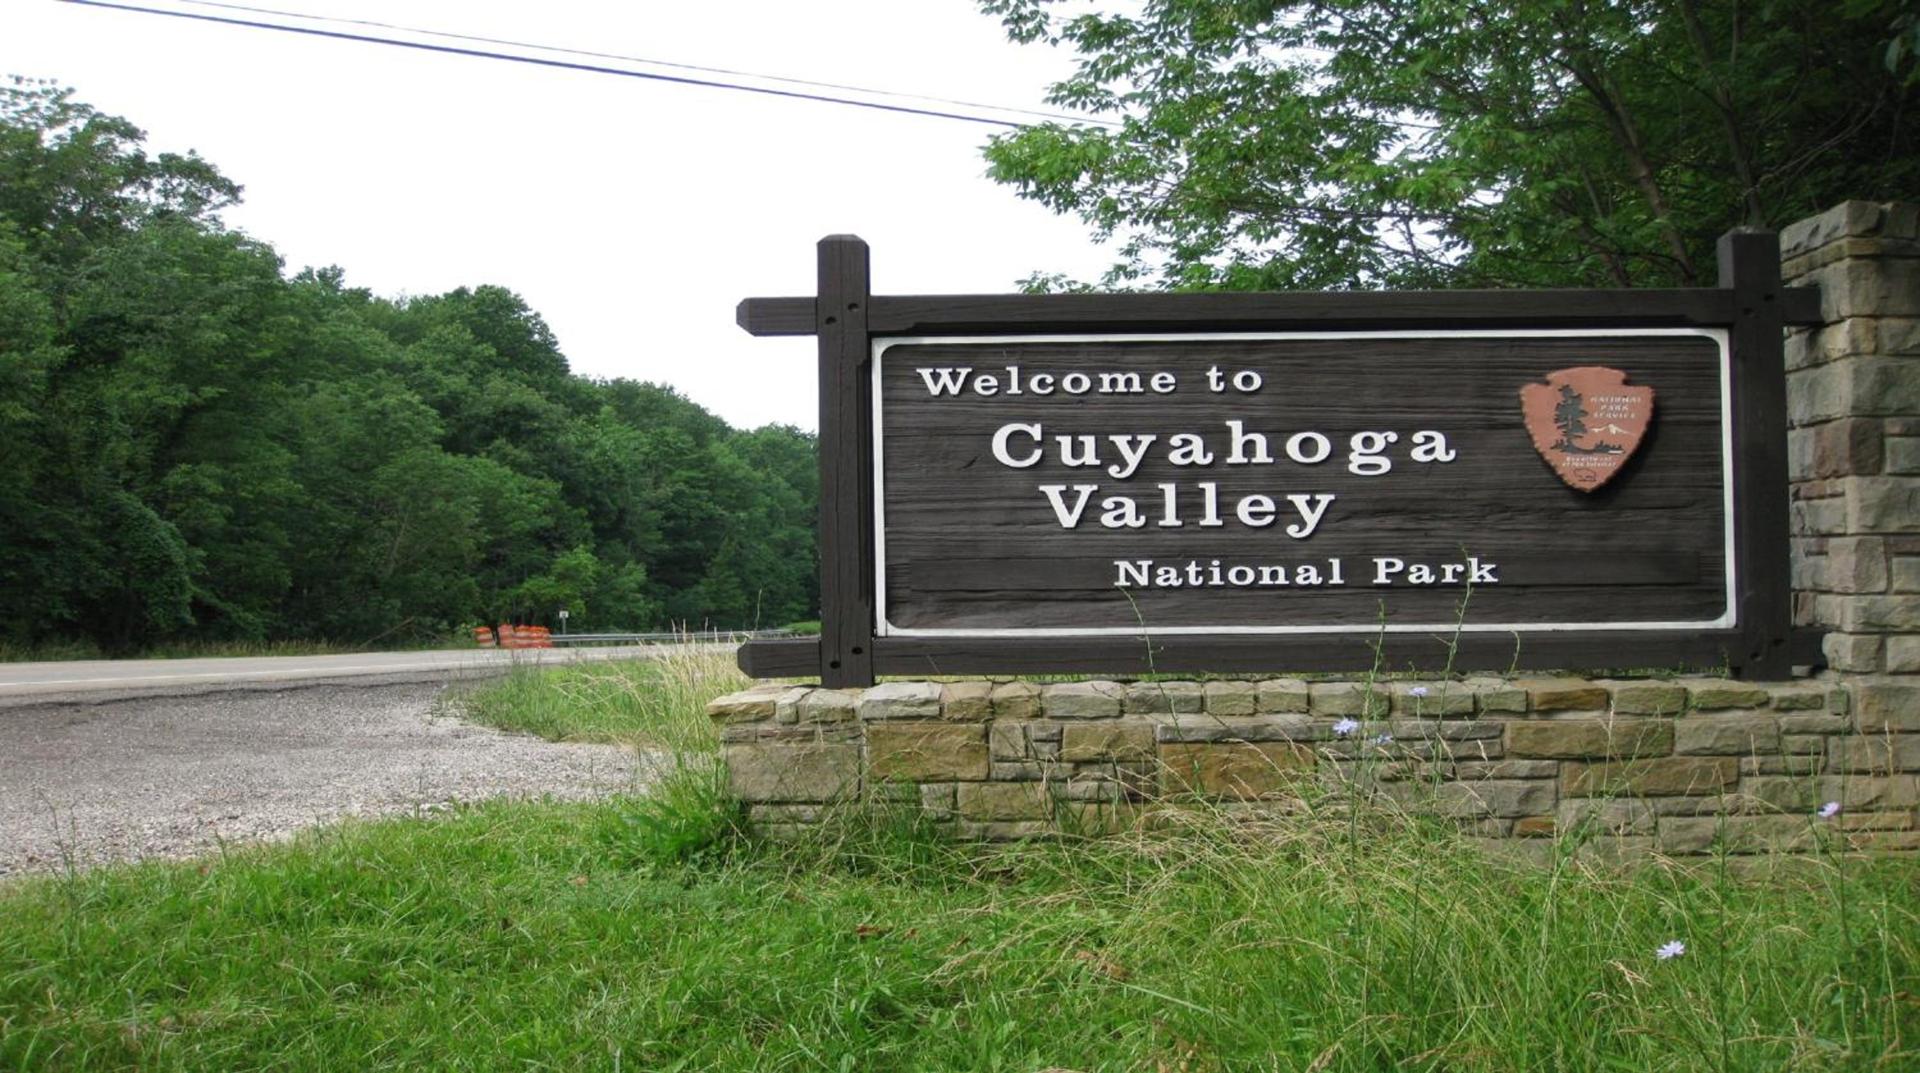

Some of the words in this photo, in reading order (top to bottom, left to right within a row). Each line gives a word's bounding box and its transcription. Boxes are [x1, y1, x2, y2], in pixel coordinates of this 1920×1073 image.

[915, 365, 1177, 396] Welcome
[1205, 365, 1263, 392] to
[991, 419, 1457, 479] Cuyahoga
[1038, 481, 1337, 540] Valley
[1113, 558, 1346, 587] National
[1371, 557, 1500, 584] Park
